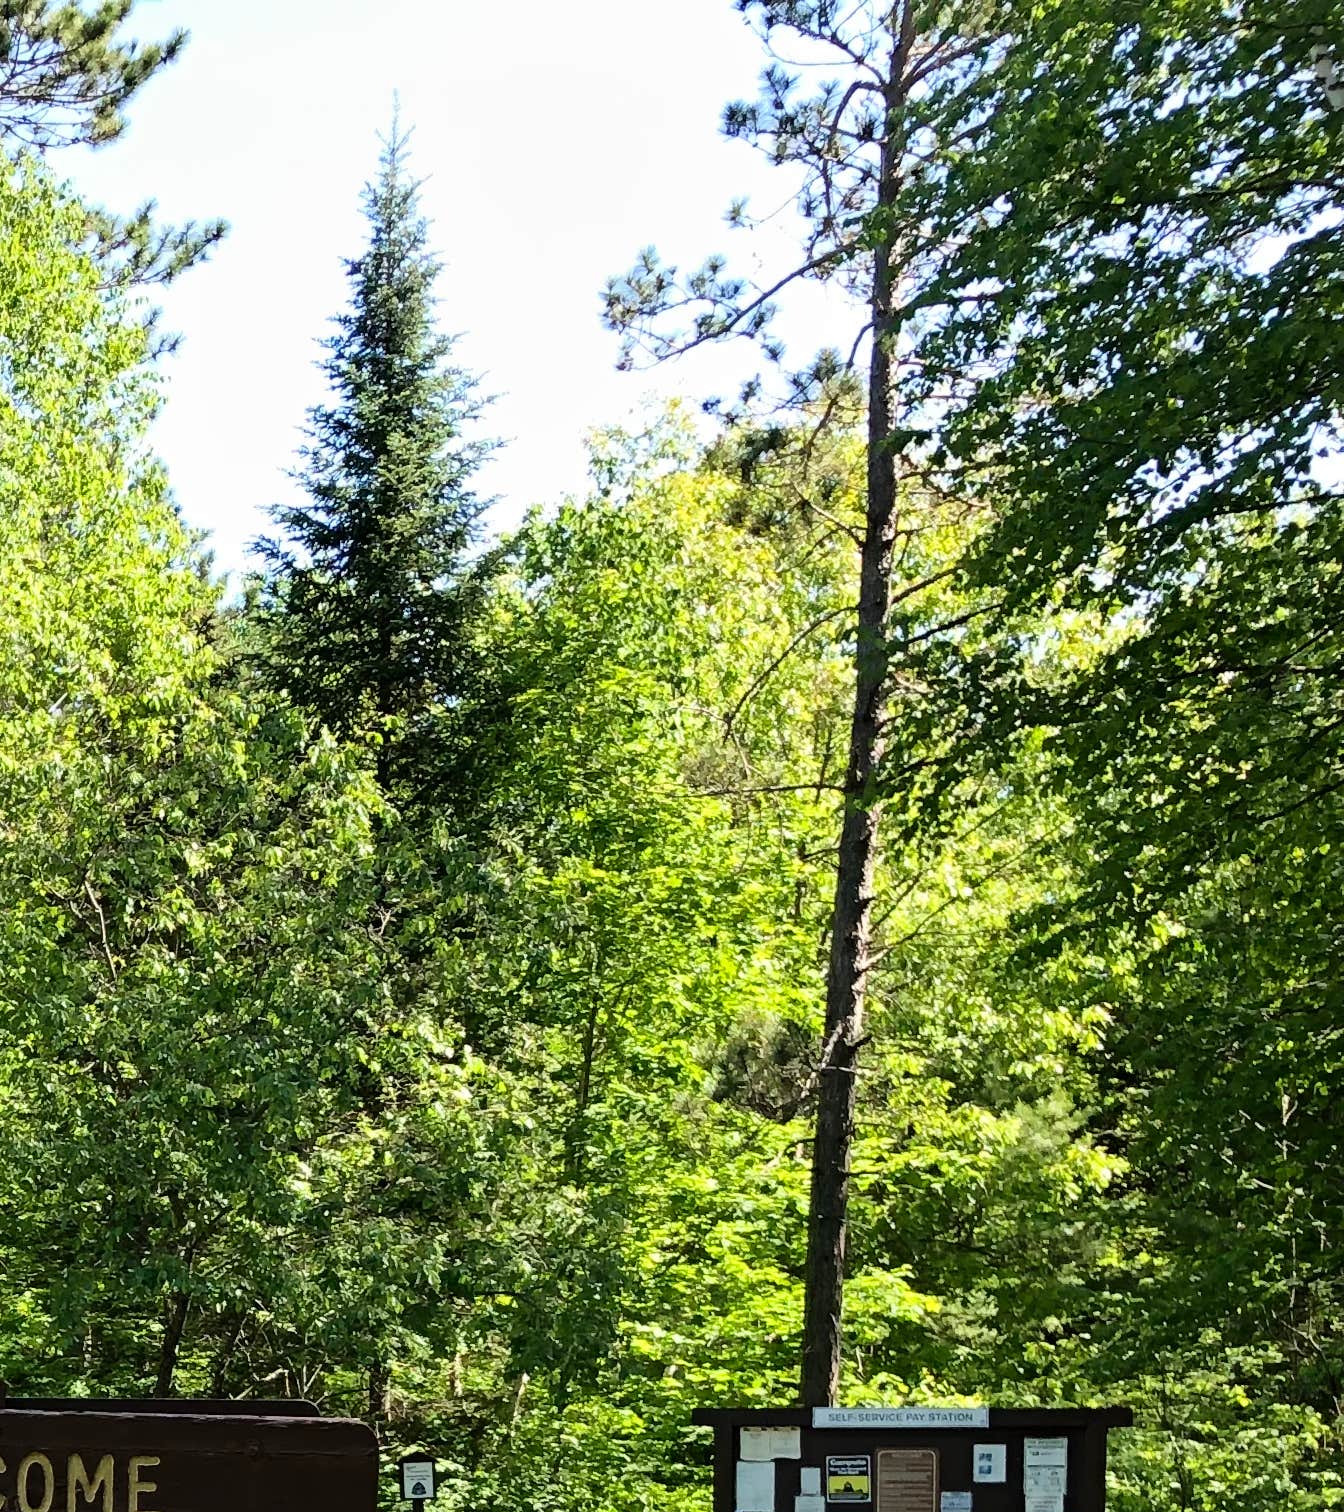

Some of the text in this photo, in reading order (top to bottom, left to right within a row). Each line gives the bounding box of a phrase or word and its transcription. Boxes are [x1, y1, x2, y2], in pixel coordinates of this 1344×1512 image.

[828, 1411, 973, 1423] SELF-SERVICE PAY STATION
